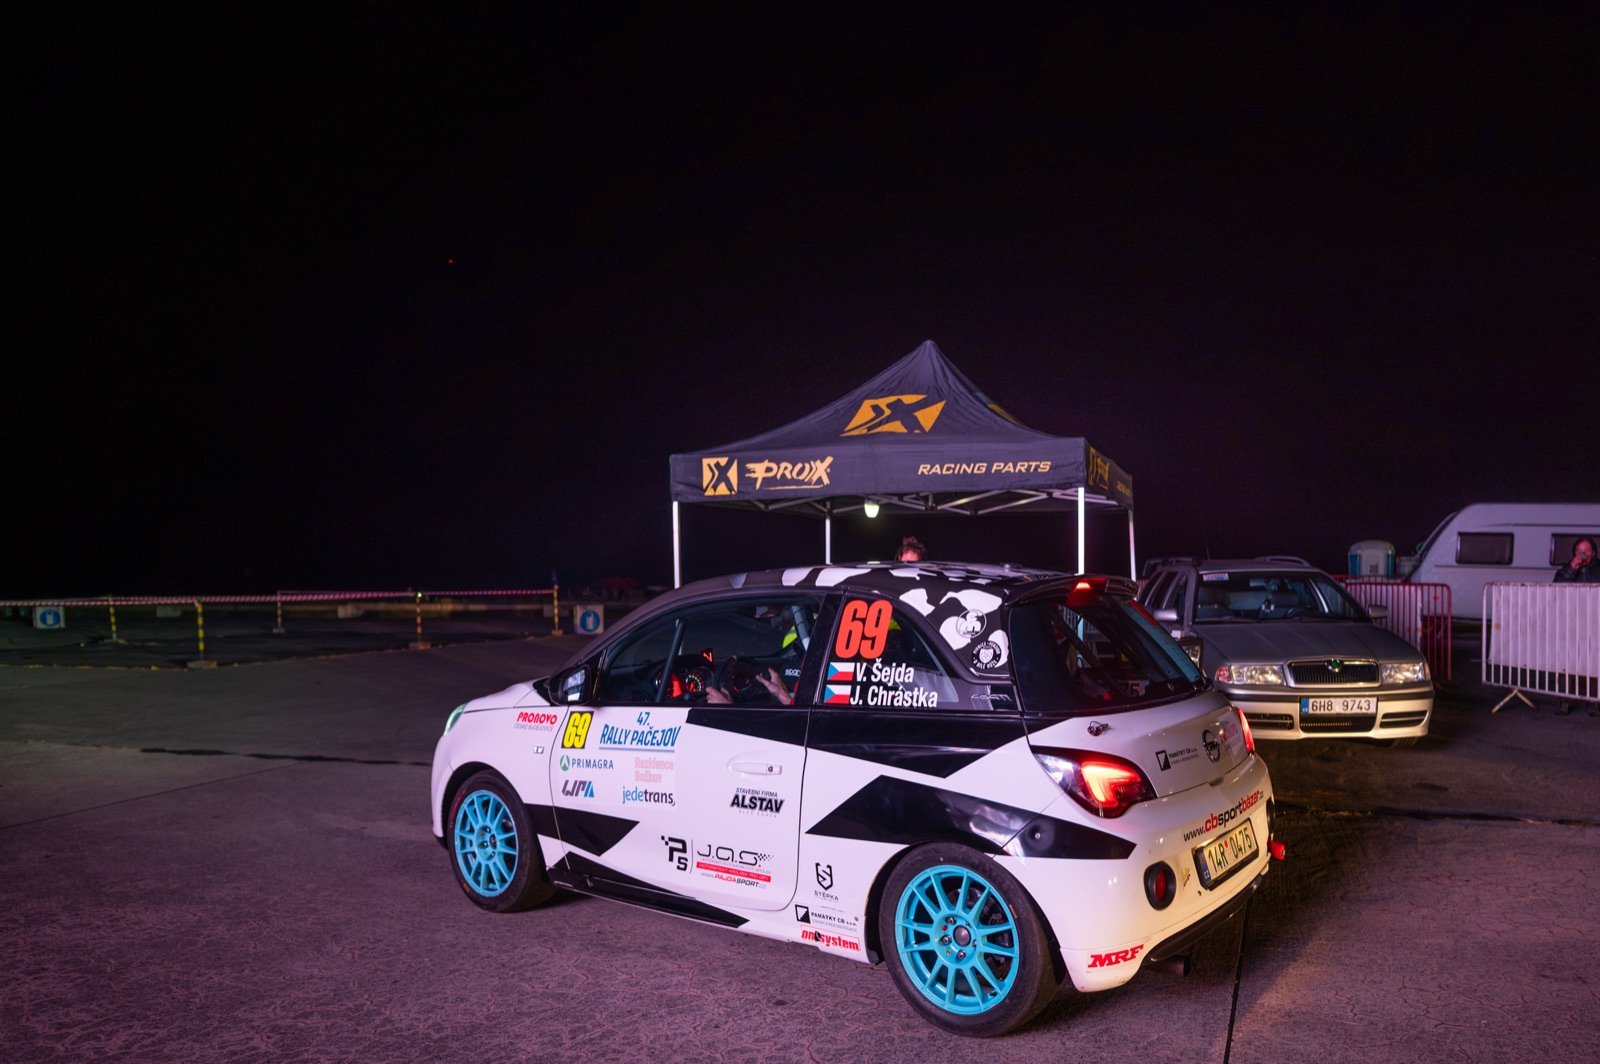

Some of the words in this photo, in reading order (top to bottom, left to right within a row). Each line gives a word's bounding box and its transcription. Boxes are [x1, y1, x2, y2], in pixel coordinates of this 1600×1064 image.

[918, 462, 987, 476] RACING
[991, 461, 1052, 474] PARTS
[835, 599, 893, 660] 69
[856, 662, 867, 682] V.
[870, 658, 914, 687] Šejda
[850, 685, 863, 706] J.
[867, 684, 938, 708] Chrástka
[1311, 700, 1333, 712] 6H8
[1342, 699, 1371, 712] 9743
[517, 711, 558, 725] PRONOVO
[637, 711, 650, 726] 47.
[562, 711, 592, 748] 69
[599, 724, 632, 745] RALLY
[630, 725, 682, 747] PAČEJOV
[571, 758, 614, 770] PRIMAGRA
[730, 793, 785, 813] ALSTAV
[761, 790, 778, 798] FIRMA
[1208, 842, 1229, 873] 14R
[1229, 827, 1252, 860] 0475
[1087, 944, 1145, 968] MRF
